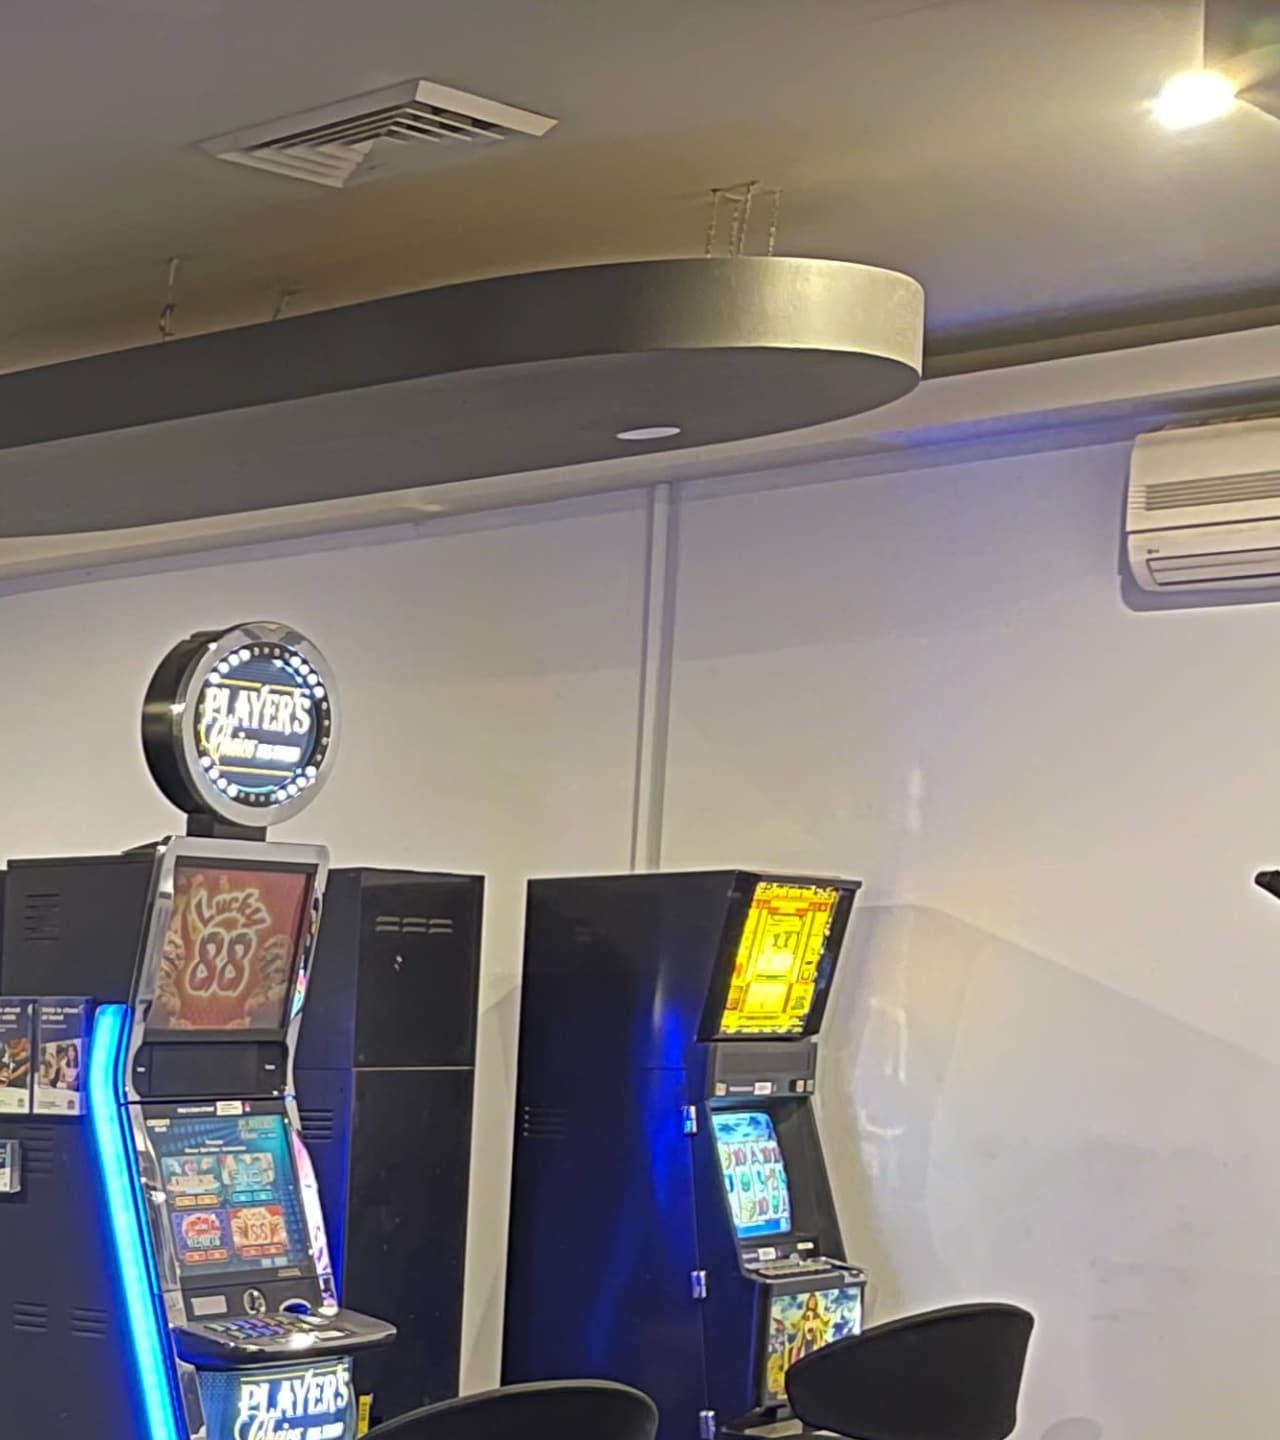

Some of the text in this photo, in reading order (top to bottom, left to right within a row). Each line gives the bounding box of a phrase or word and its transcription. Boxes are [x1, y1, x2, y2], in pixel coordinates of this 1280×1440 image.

[204, 684, 311, 736] PLAYER'S
[191, 888, 272, 930] Lucky
[186, 927, 257, 997] 88
[238, 1364, 351, 1420] PLAYER'S
